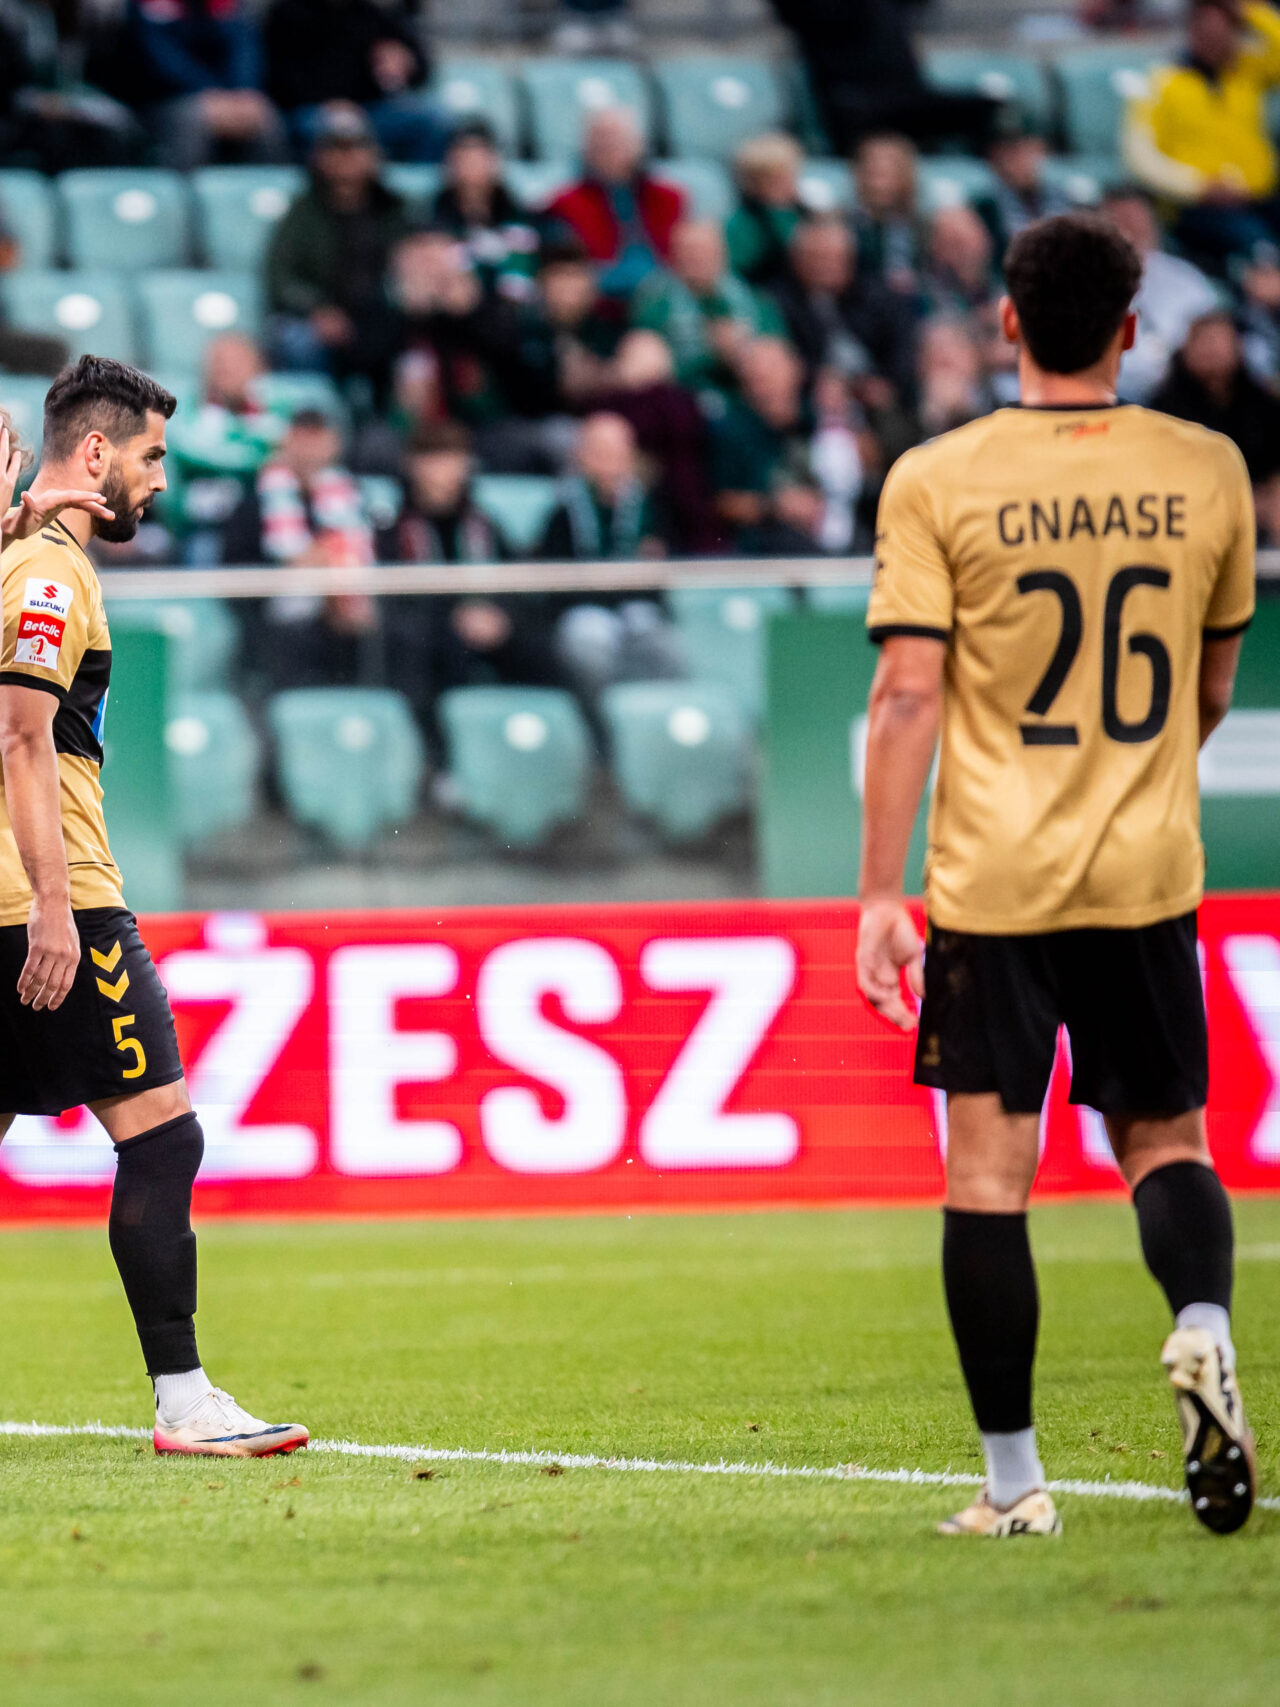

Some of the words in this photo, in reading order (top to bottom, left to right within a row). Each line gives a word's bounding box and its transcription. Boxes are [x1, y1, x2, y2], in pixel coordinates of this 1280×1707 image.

[998, 492, 1186, 546] GNAASE
[23, 620, 61, 638] Betclic
[29, 599, 65, 614] SUZUKI
[1016, 565, 1172, 746] 26
[112, 1014, 147, 1079] 5
